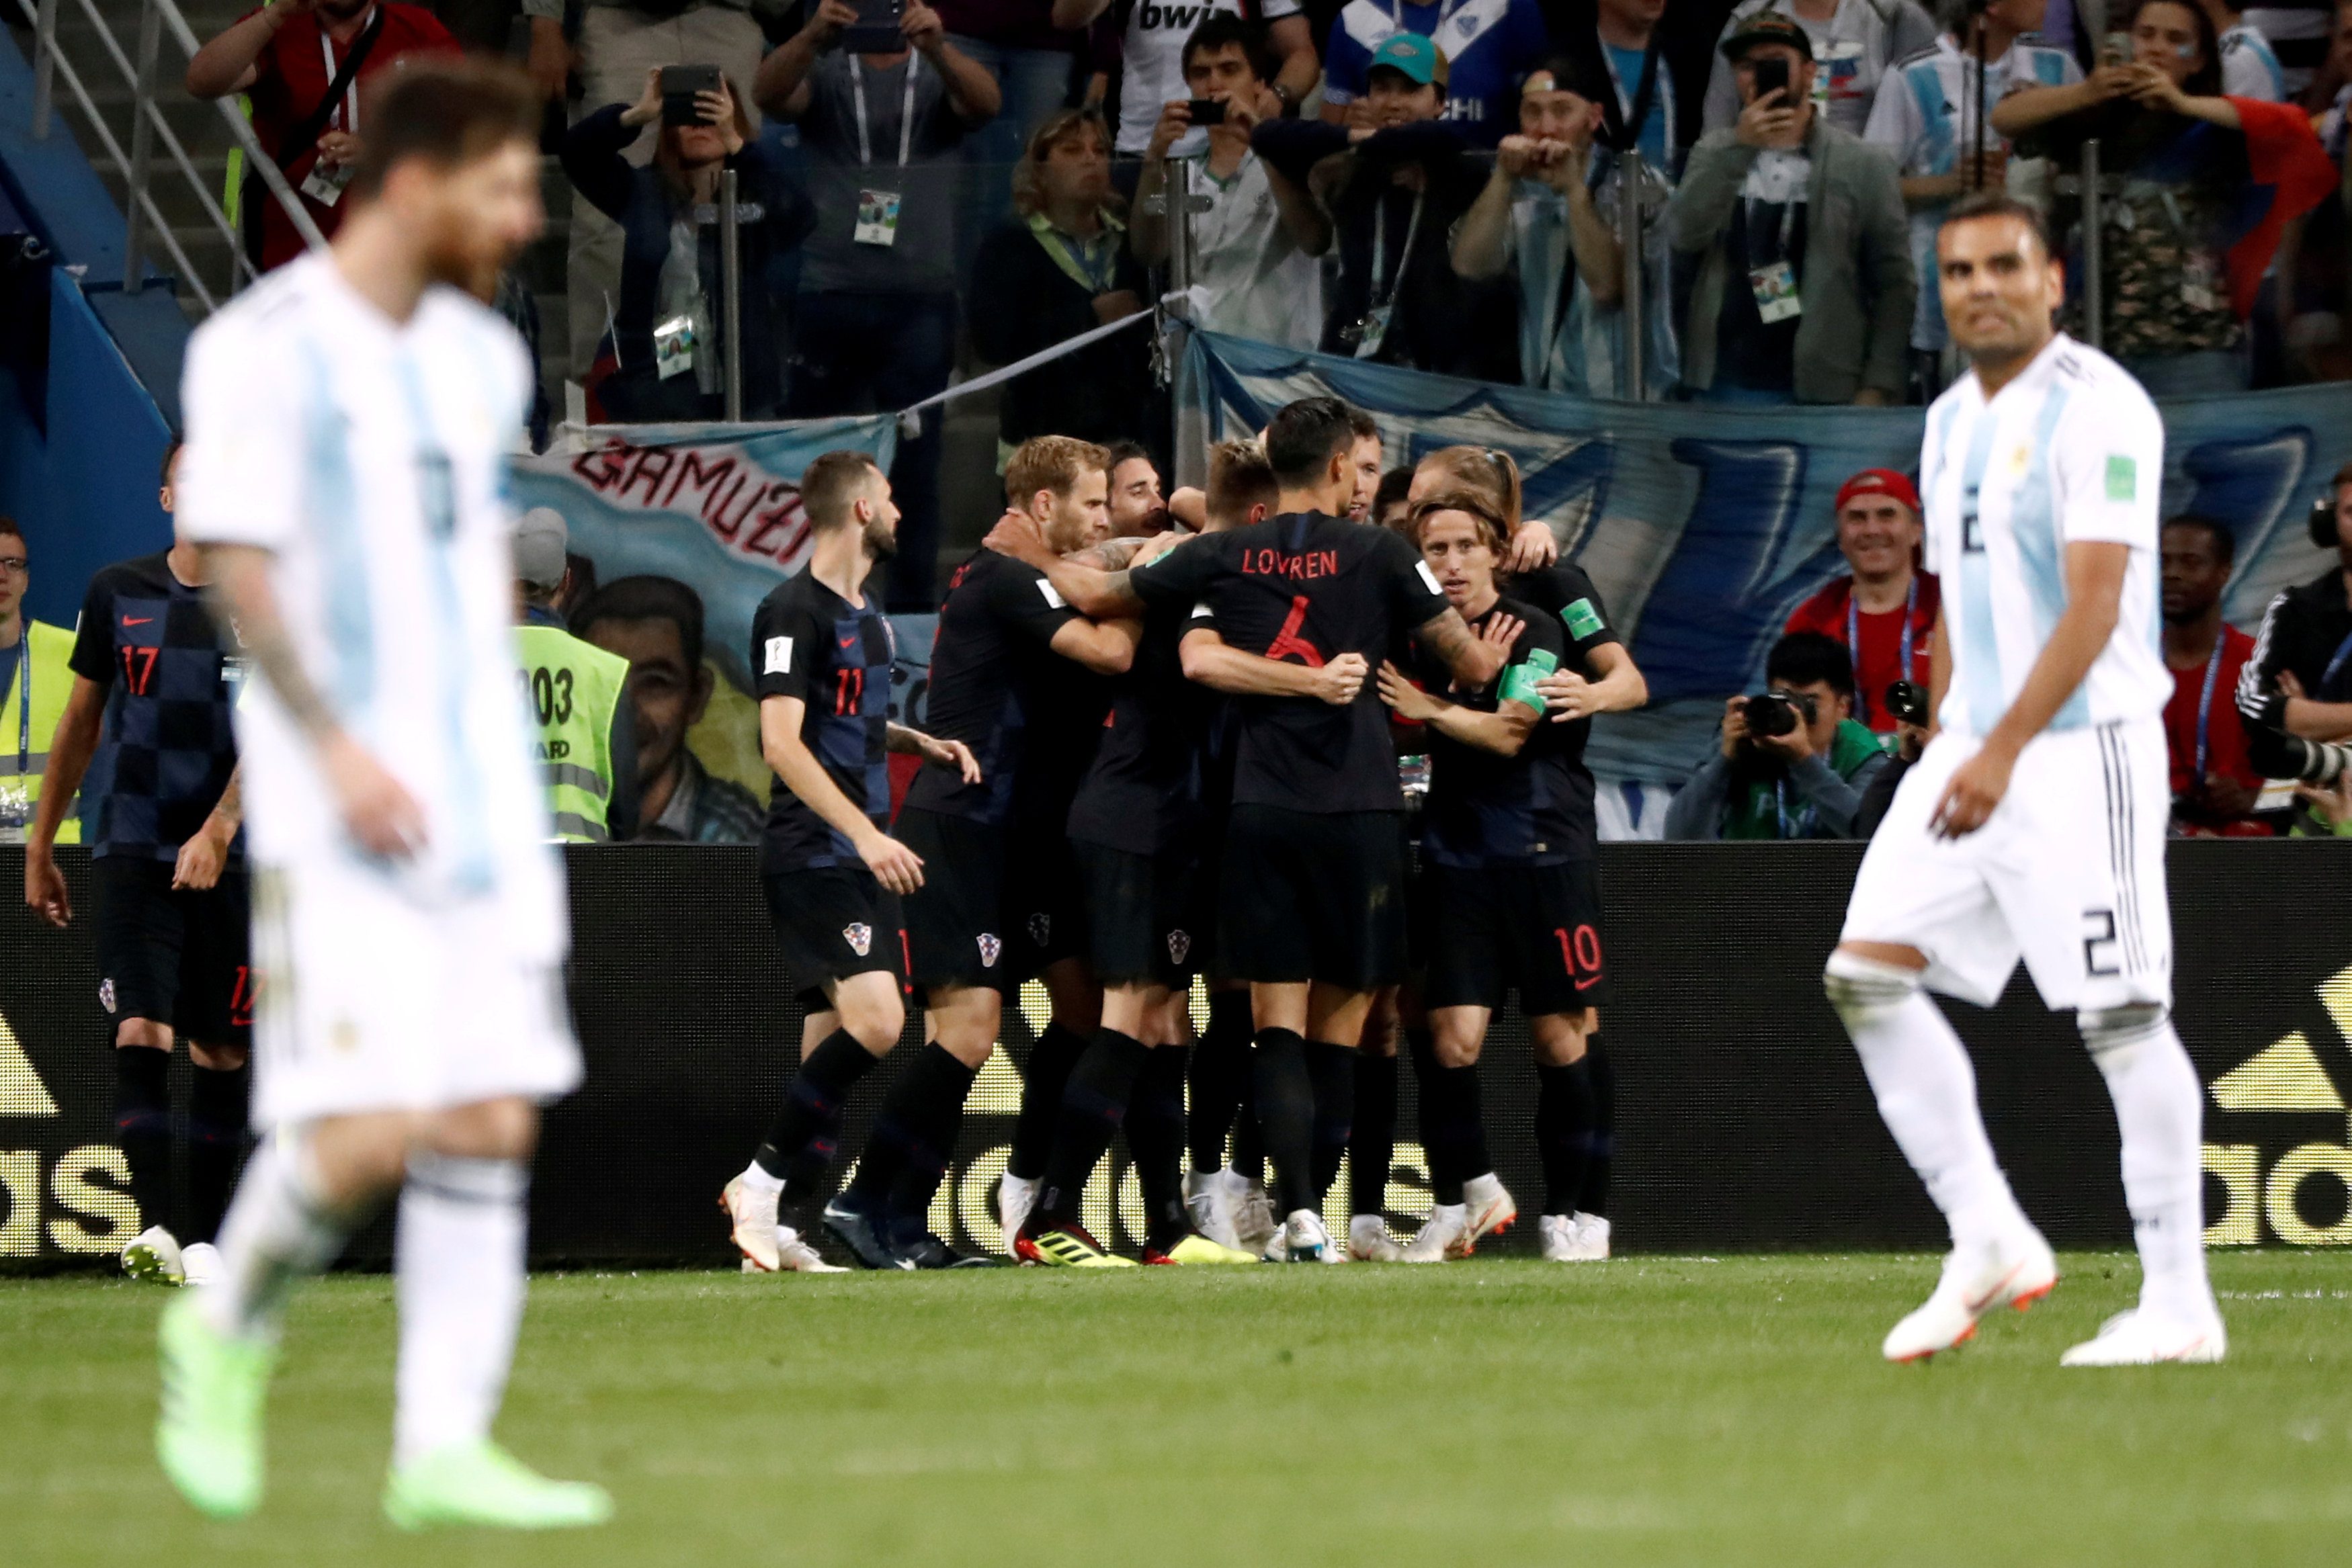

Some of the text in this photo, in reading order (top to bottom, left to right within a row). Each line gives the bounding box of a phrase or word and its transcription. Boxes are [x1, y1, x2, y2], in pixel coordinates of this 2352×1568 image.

[1242, 548, 1337, 580] LOVREN
[1265, 595, 1325, 669] 6
[122, 645, 160, 696] 17
[835, 668, 863, 716] 11
[1554, 924, 1602, 975] 10
[2081, 908, 2120, 978] 2
